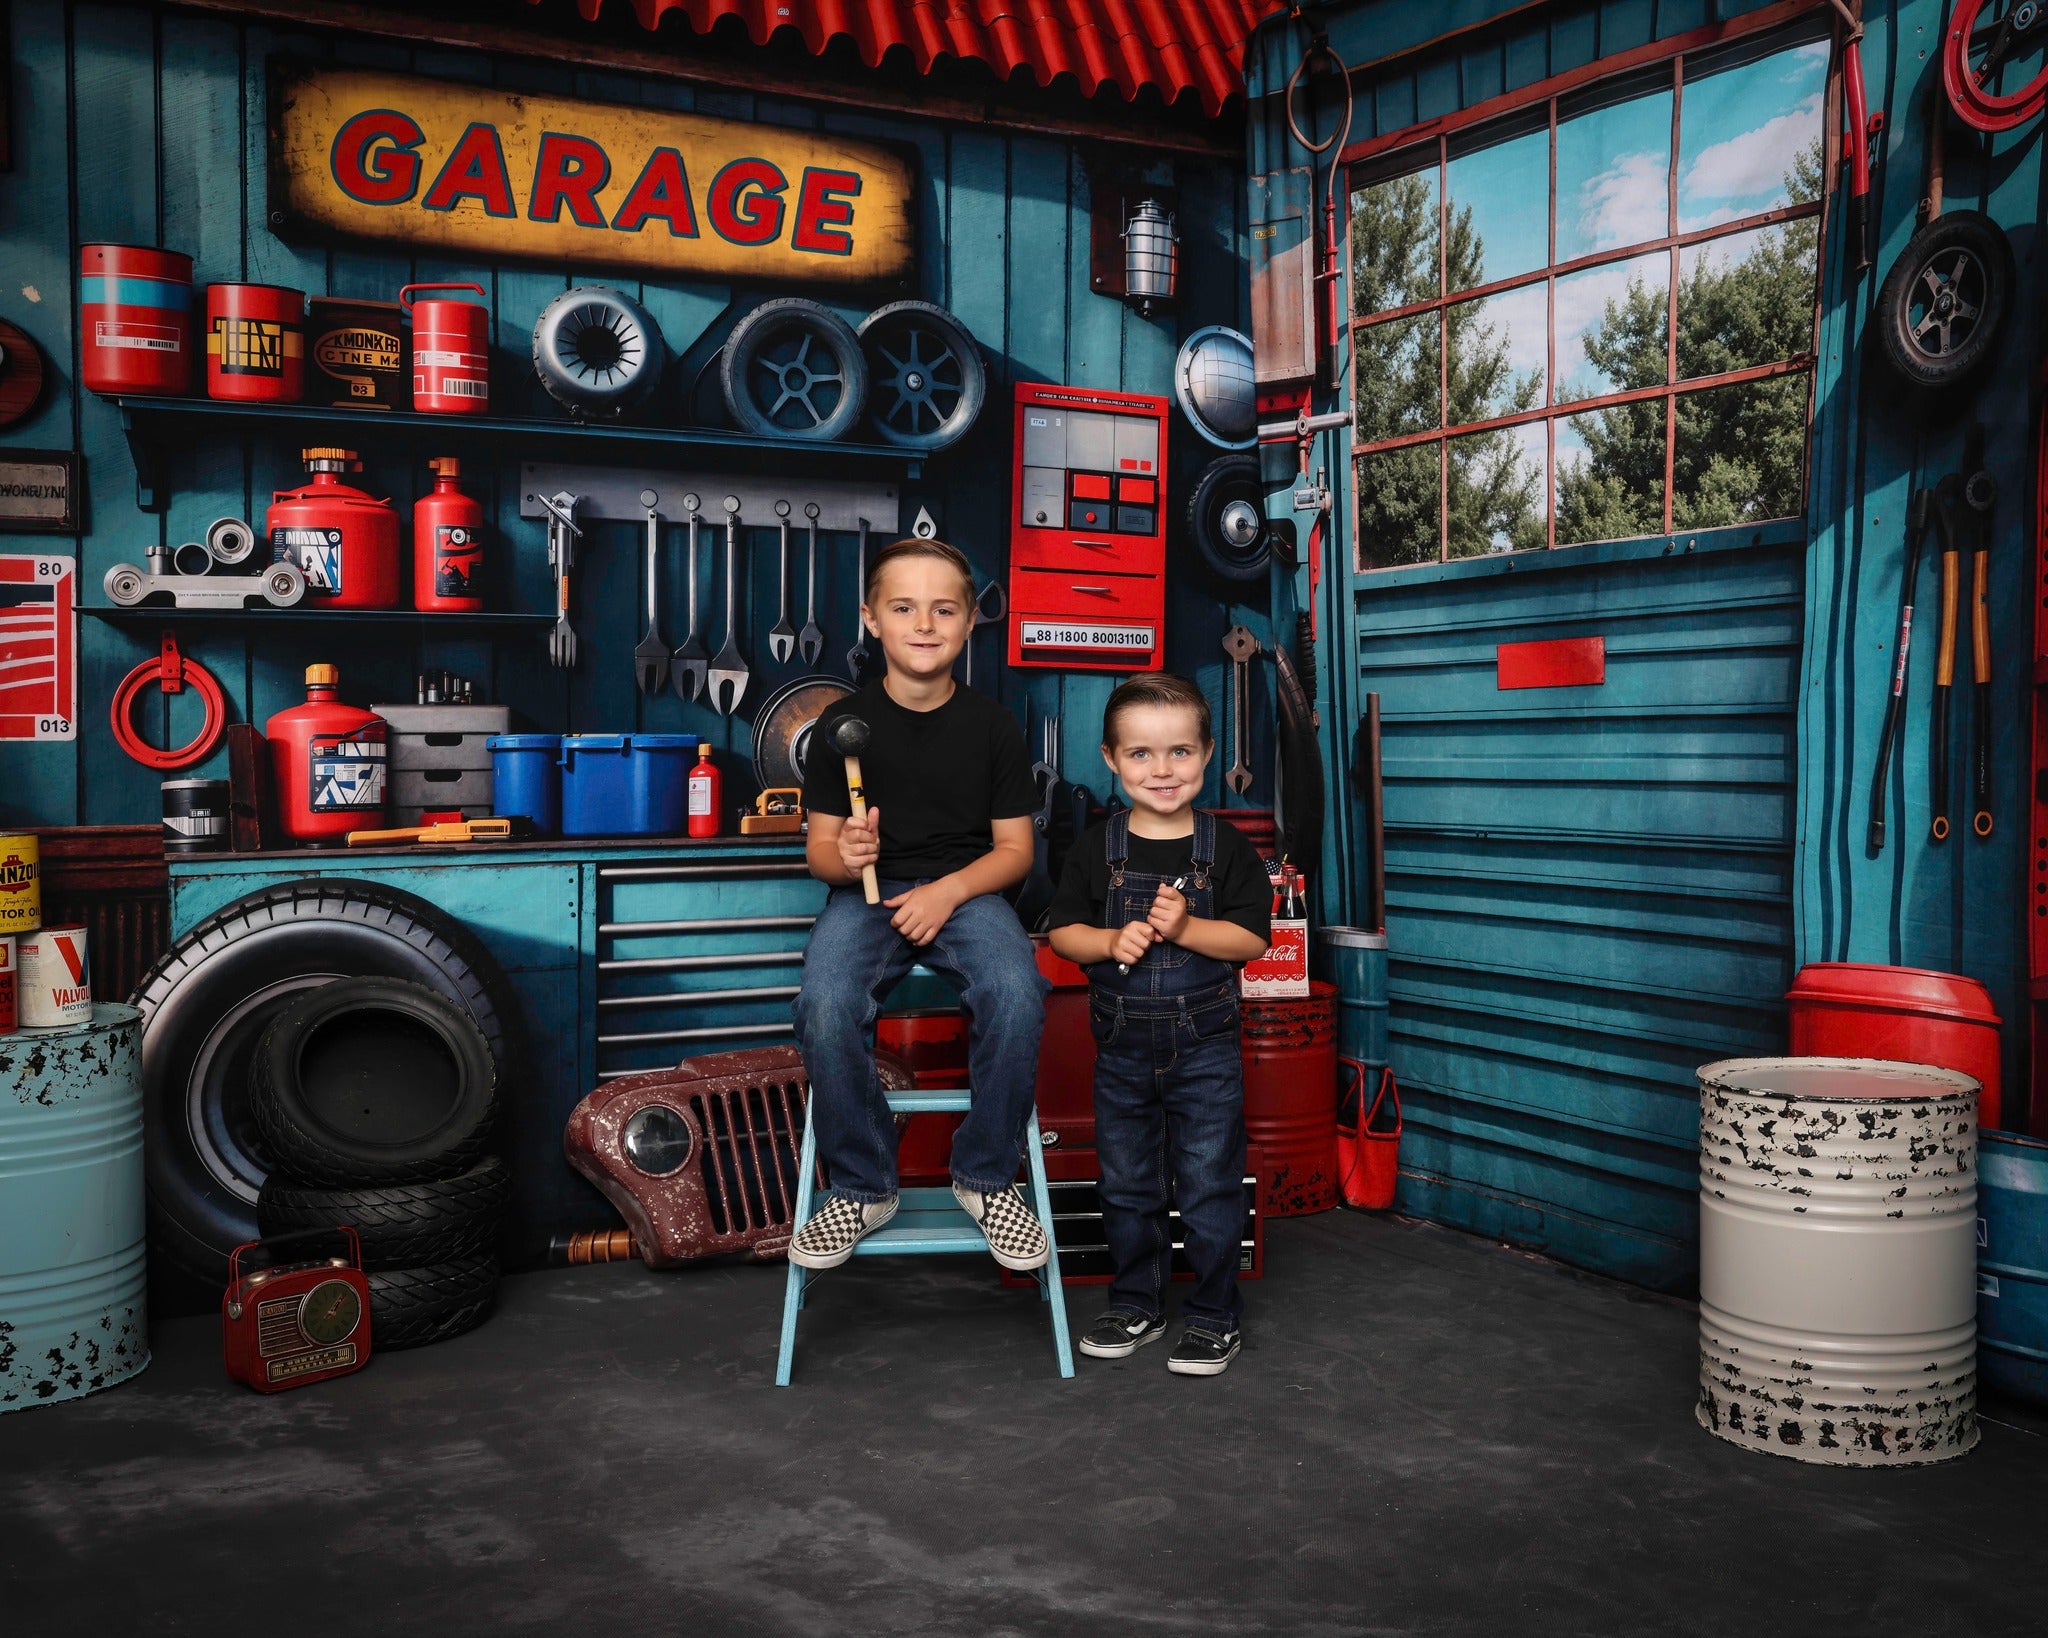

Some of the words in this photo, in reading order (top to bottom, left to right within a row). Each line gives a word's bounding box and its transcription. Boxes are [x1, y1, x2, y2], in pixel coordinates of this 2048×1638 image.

[330, 108, 862, 257] GARAGE
[38, 562, 62, 576] 80
[1037, 630, 1052, 641] 88
[40, 719, 70, 733] 013
[0, 908, 25, 919] TOR
[52, 986, 91, 1007] VALVOL
